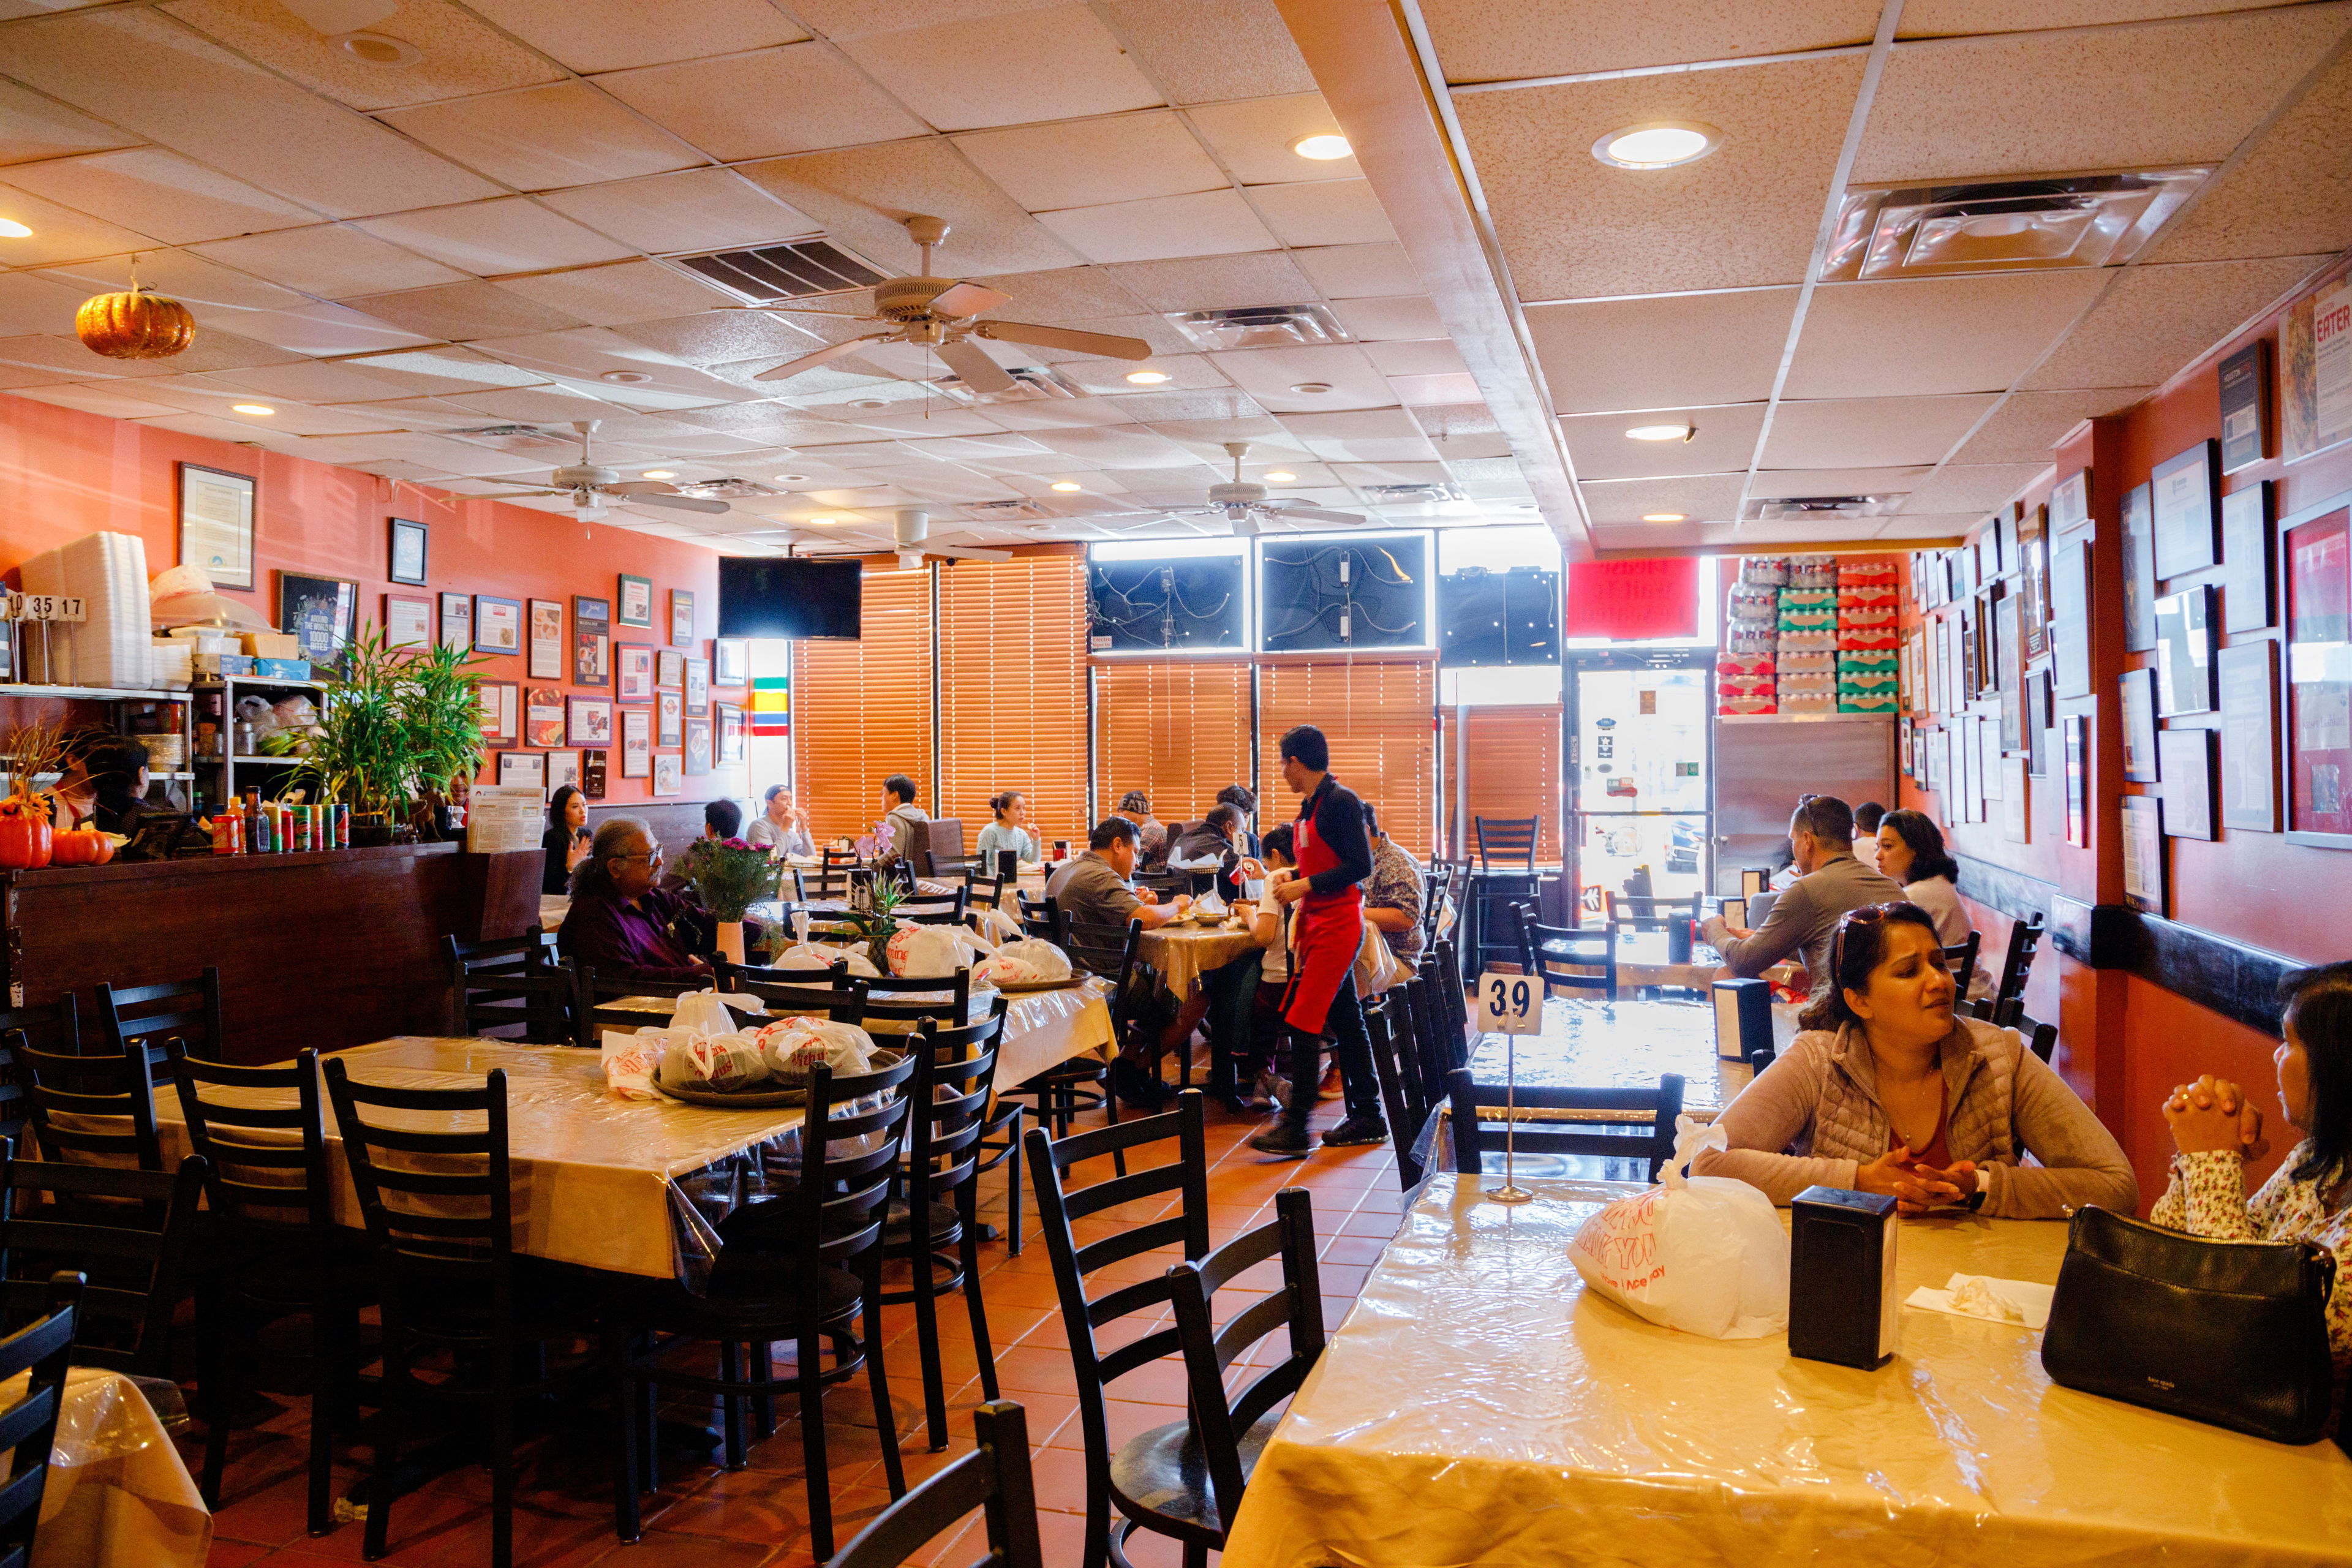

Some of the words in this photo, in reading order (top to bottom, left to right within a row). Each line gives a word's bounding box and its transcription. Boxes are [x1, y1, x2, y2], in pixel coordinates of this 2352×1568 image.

[2316, 304, 2350, 342] EATER
[7, 595, 23, 611] 10
[33, 597, 52, 612] 35
[62, 599, 80, 614] 17
[310, 631, 328, 643] 10000
[1490, 979, 1530, 1018] 39
